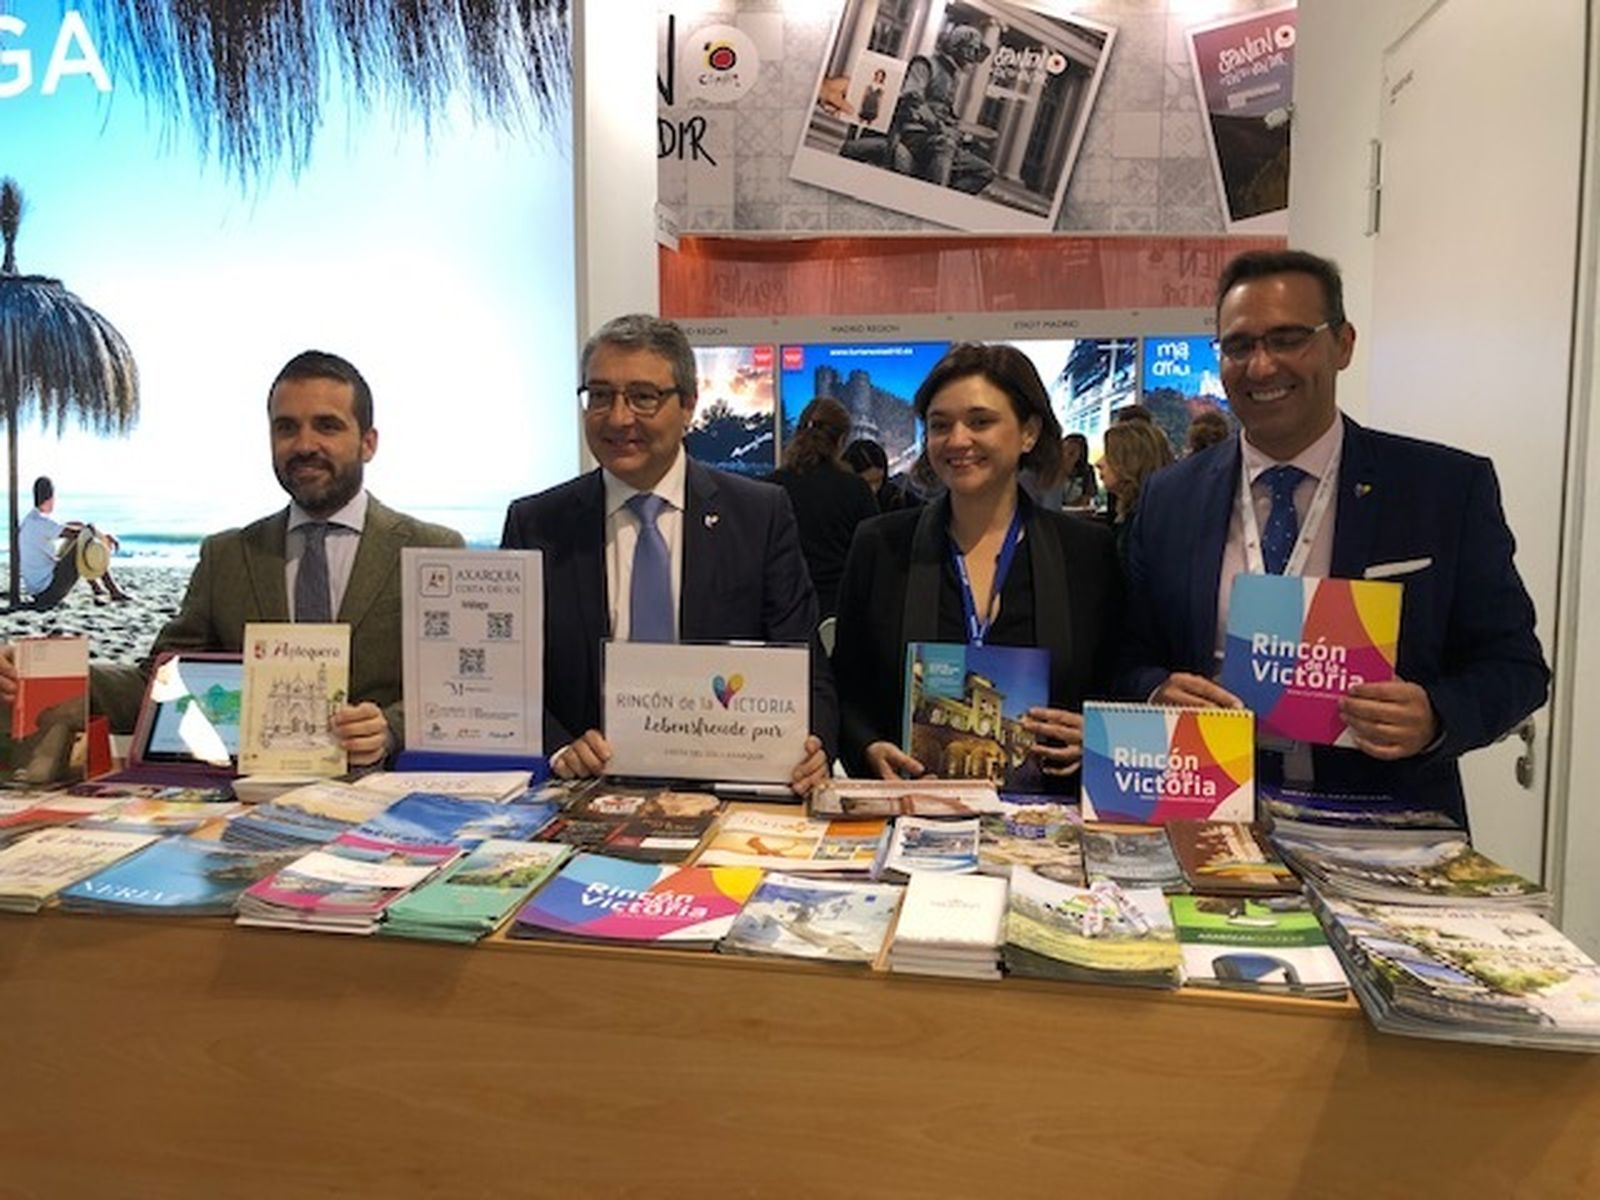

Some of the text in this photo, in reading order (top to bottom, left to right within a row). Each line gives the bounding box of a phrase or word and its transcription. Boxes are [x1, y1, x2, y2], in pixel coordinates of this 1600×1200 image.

[657, 115, 717, 166] DIR
[832, 324, 864, 333] MADRID
[1252, 632, 1347, 663] Rincón
[616, 692, 673, 709] RINCÓN
[679, 695, 695, 711] de
[1114, 748, 1199, 771] Rincón
[1115, 772, 1217, 796] Victoria
[587, 882, 694, 902] Rincón
[582, 893, 708, 917] Victoria
